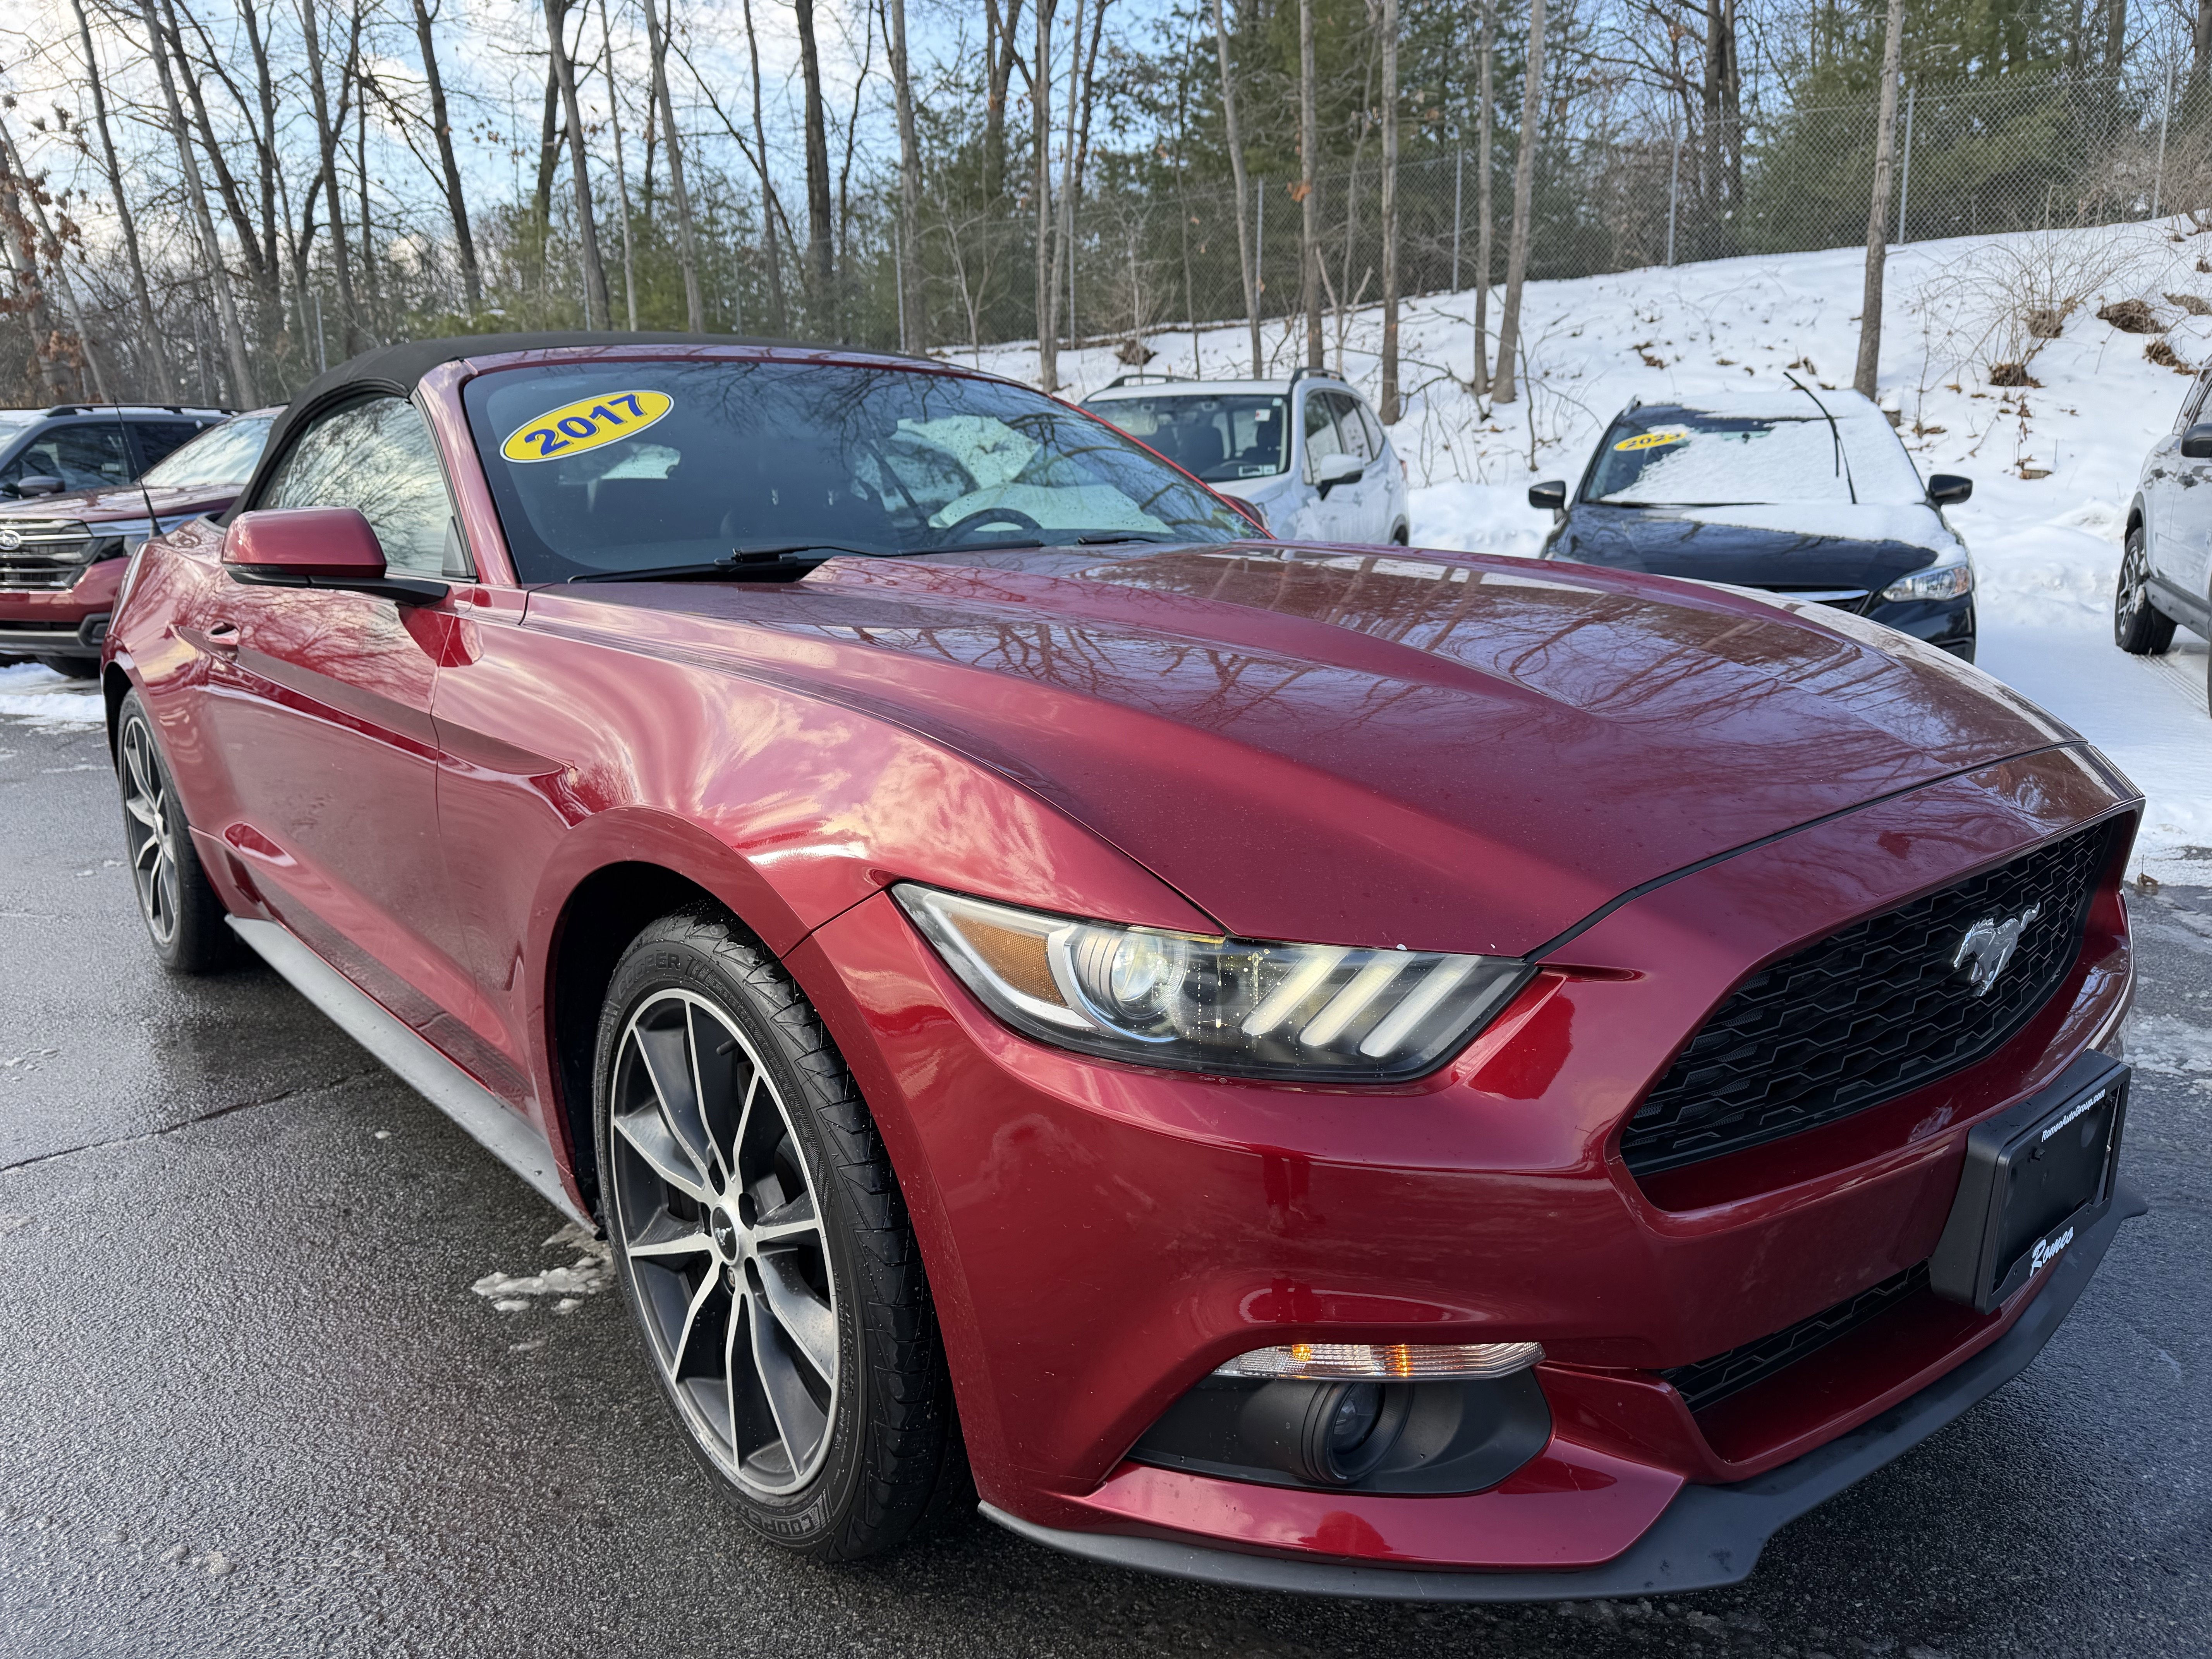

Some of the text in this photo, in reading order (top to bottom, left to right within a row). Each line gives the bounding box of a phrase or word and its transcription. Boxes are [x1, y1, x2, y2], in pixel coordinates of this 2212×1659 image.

[525, 394, 646, 456] 2017
[617, 953, 681, 1000] COOPER
[2041, 1089, 2105, 1142] RomeoAutoGroup.com
[2030, 1226, 2073, 1277] Romeo
